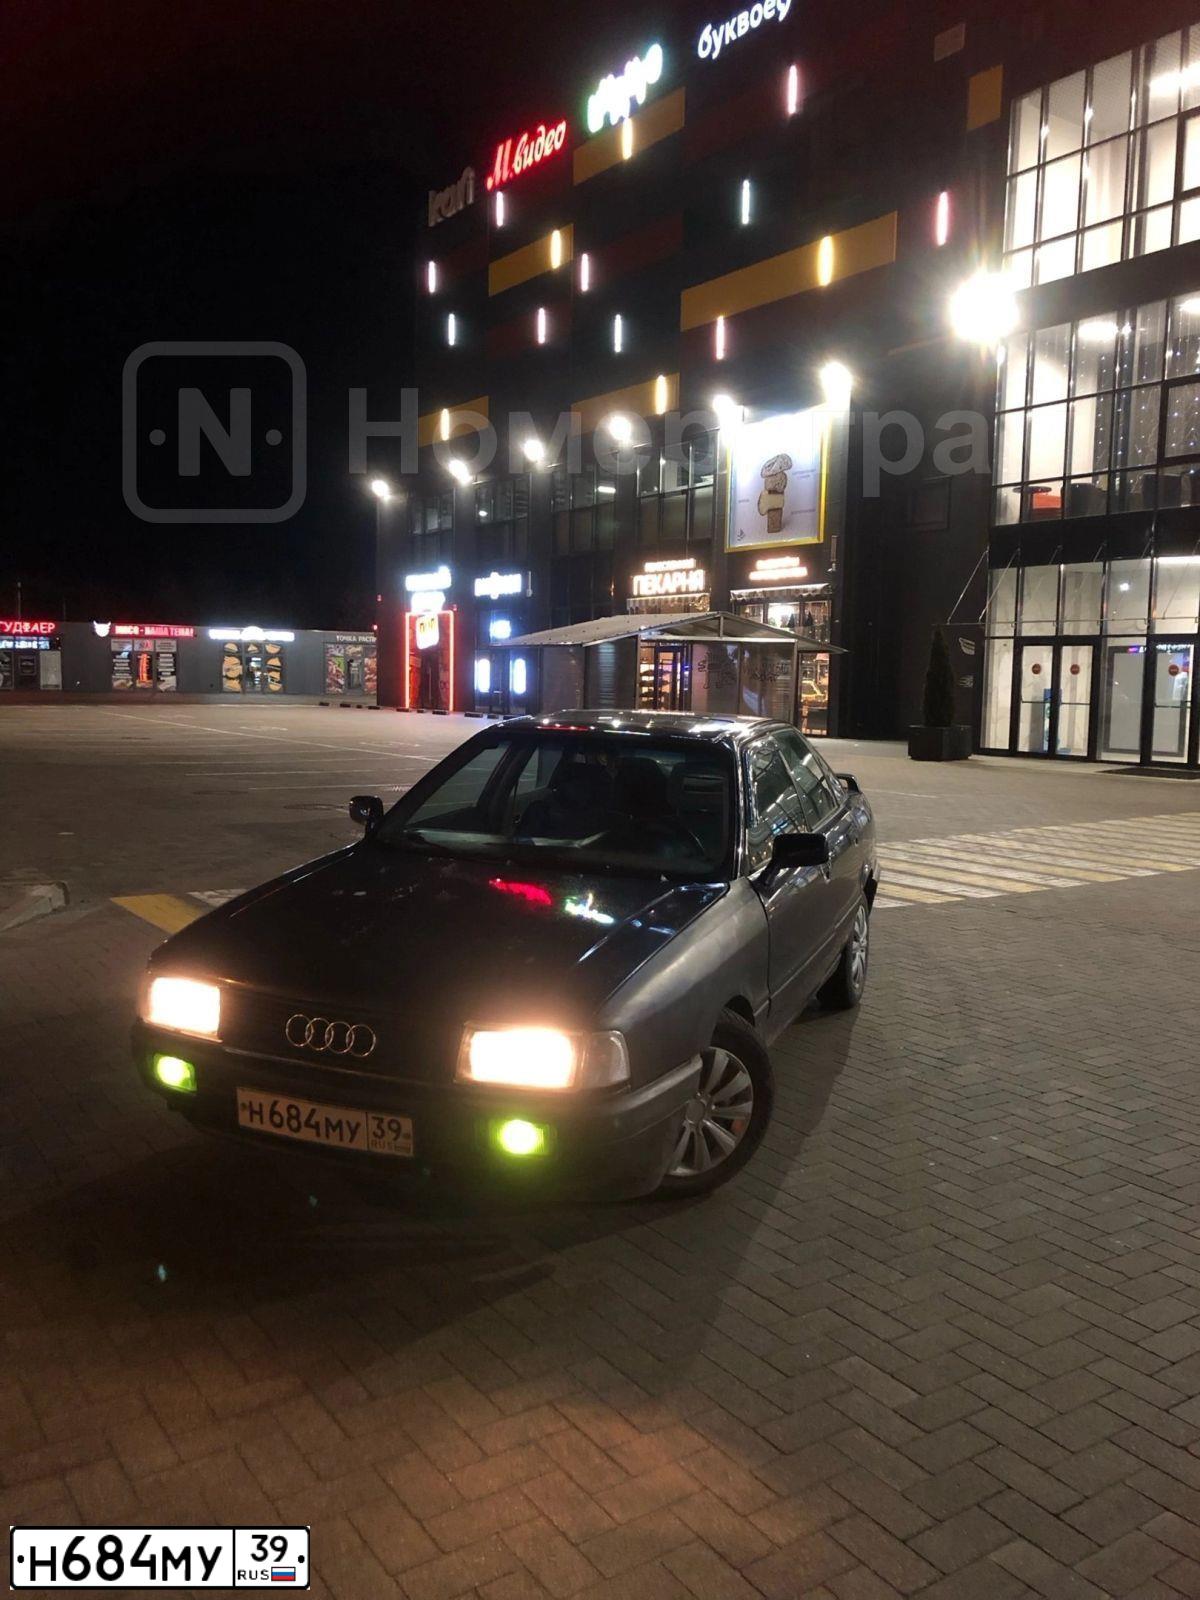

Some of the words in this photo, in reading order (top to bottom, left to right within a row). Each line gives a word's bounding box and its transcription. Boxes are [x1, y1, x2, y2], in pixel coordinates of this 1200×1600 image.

[633, 570, 705, 596] ПЕКАРНЯ
[249, 1100, 361, 1143] Н684МУ
[371, 1116, 401, 1141] 39
